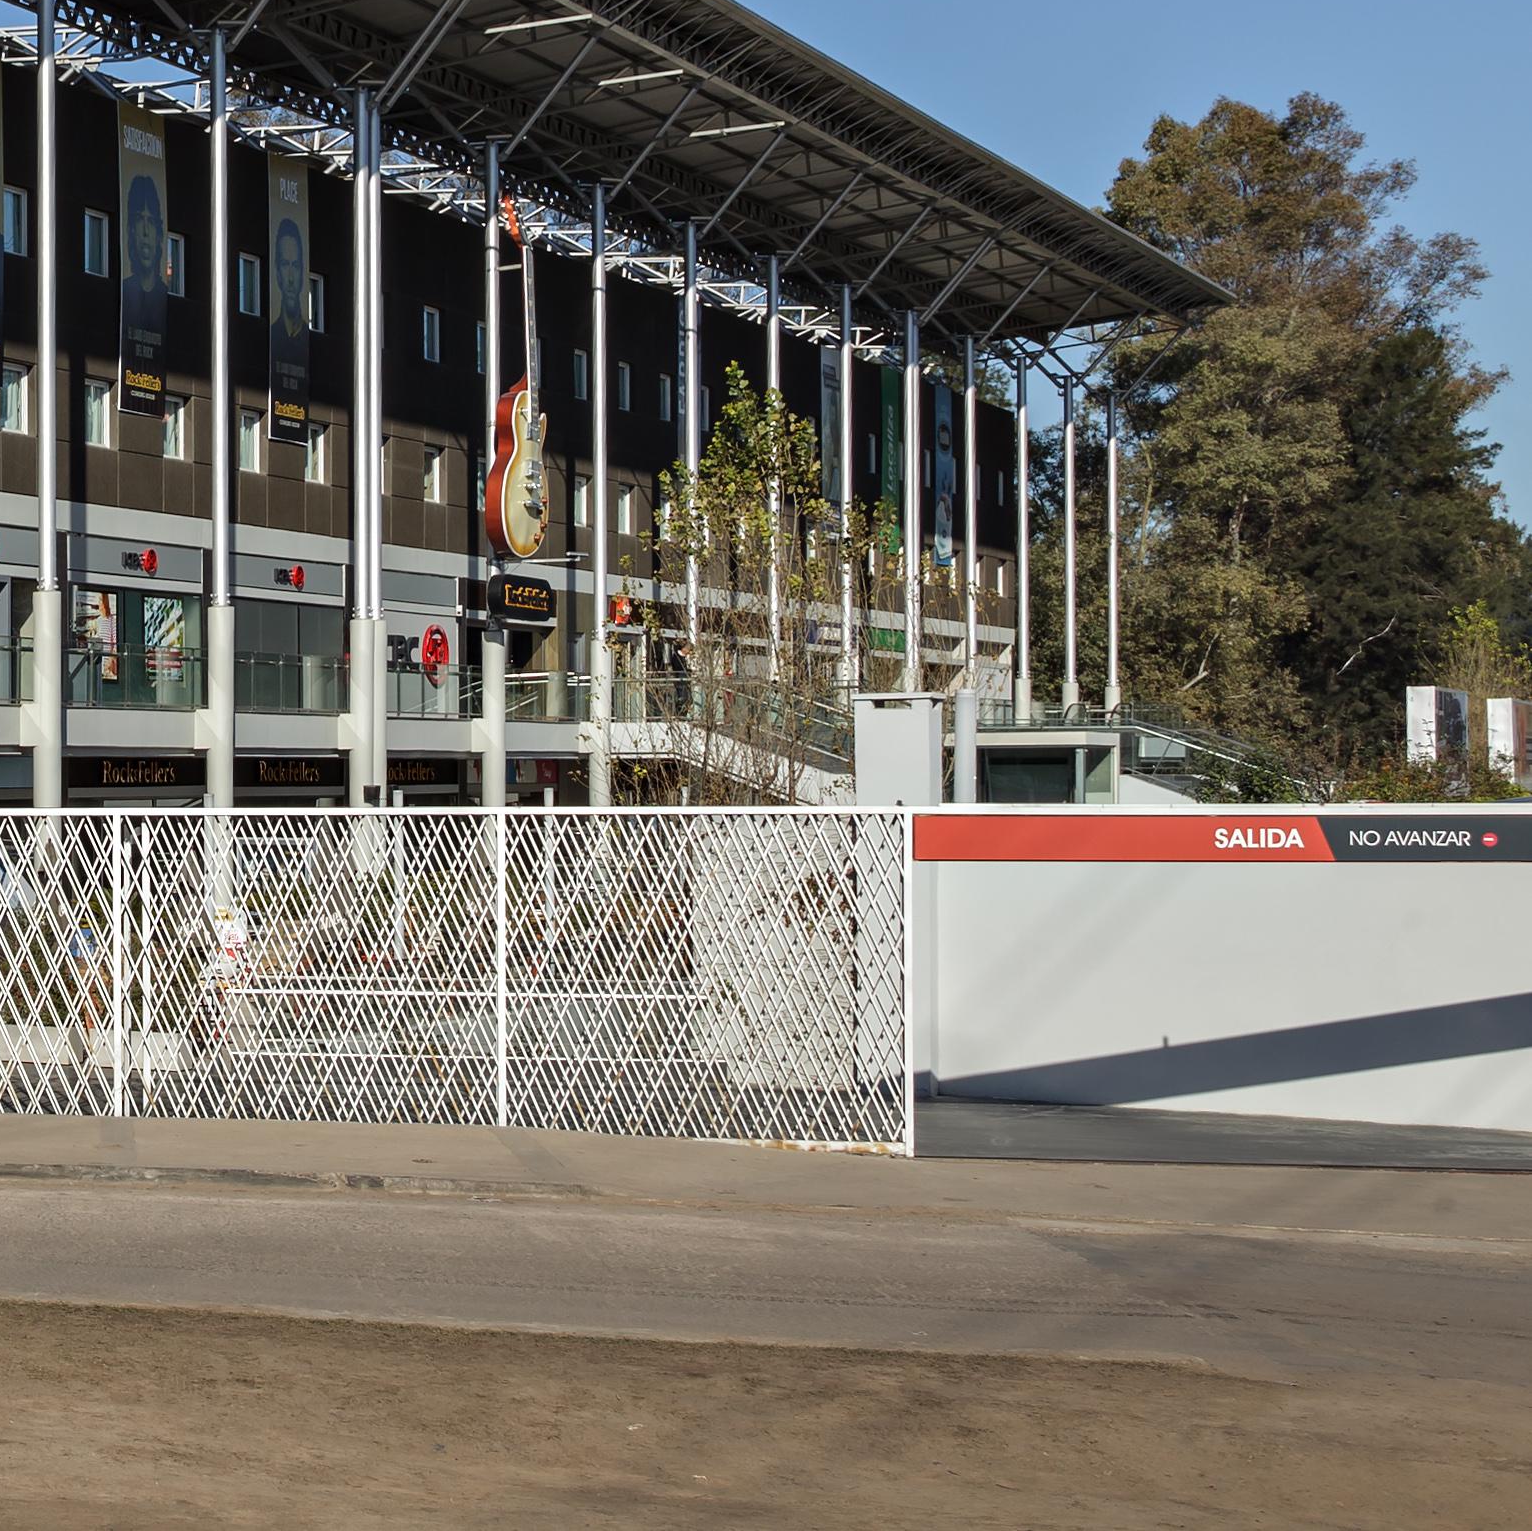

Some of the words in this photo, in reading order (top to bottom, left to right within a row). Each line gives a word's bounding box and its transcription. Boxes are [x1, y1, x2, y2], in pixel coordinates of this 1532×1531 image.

[280, 178, 298, 204] PLACE
[1214, 828, 1305, 848] SALIDA
[1349, 831, 1380, 846] NO
[1384, 831, 1471, 847] AVANZAR
